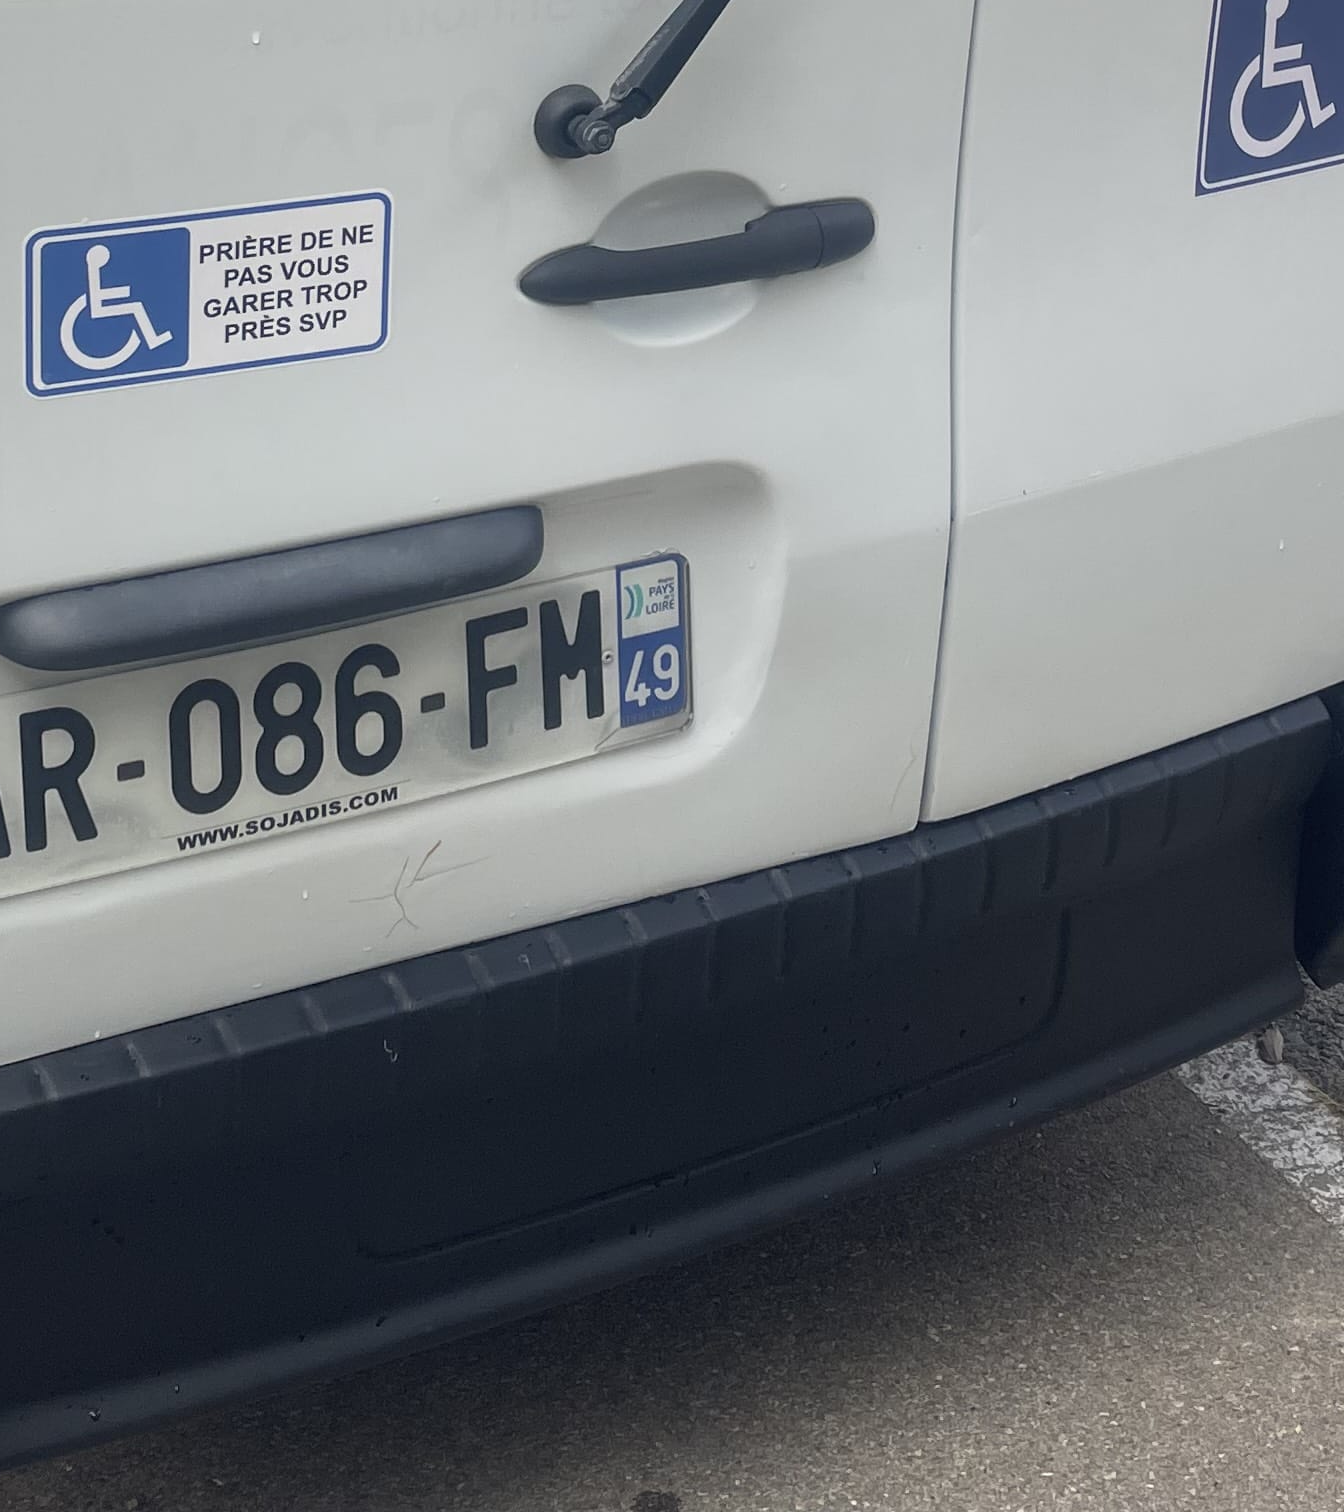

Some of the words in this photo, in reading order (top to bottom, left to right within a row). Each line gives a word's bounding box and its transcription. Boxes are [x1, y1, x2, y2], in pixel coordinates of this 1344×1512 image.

[199, 235, 293, 264] PRIÈRE
[300, 228, 333, 252] DE
[342, 223, 375, 246] NE
[223, 262, 273, 288] PAS
[280, 253, 350, 281] VOUS
[203, 289, 293, 318] GARER
[301, 279, 368, 305] TROP
[224, 313, 290, 343] PRÈS
[299, 308, 347, 332] SVP
[646, 599, 675, 614] LOIRE
[649, 583, 674, 597] PAYS
[624, 643, 680, 707] 49
[176, 786, 398, 851] WWW.SOJADIS.COM
